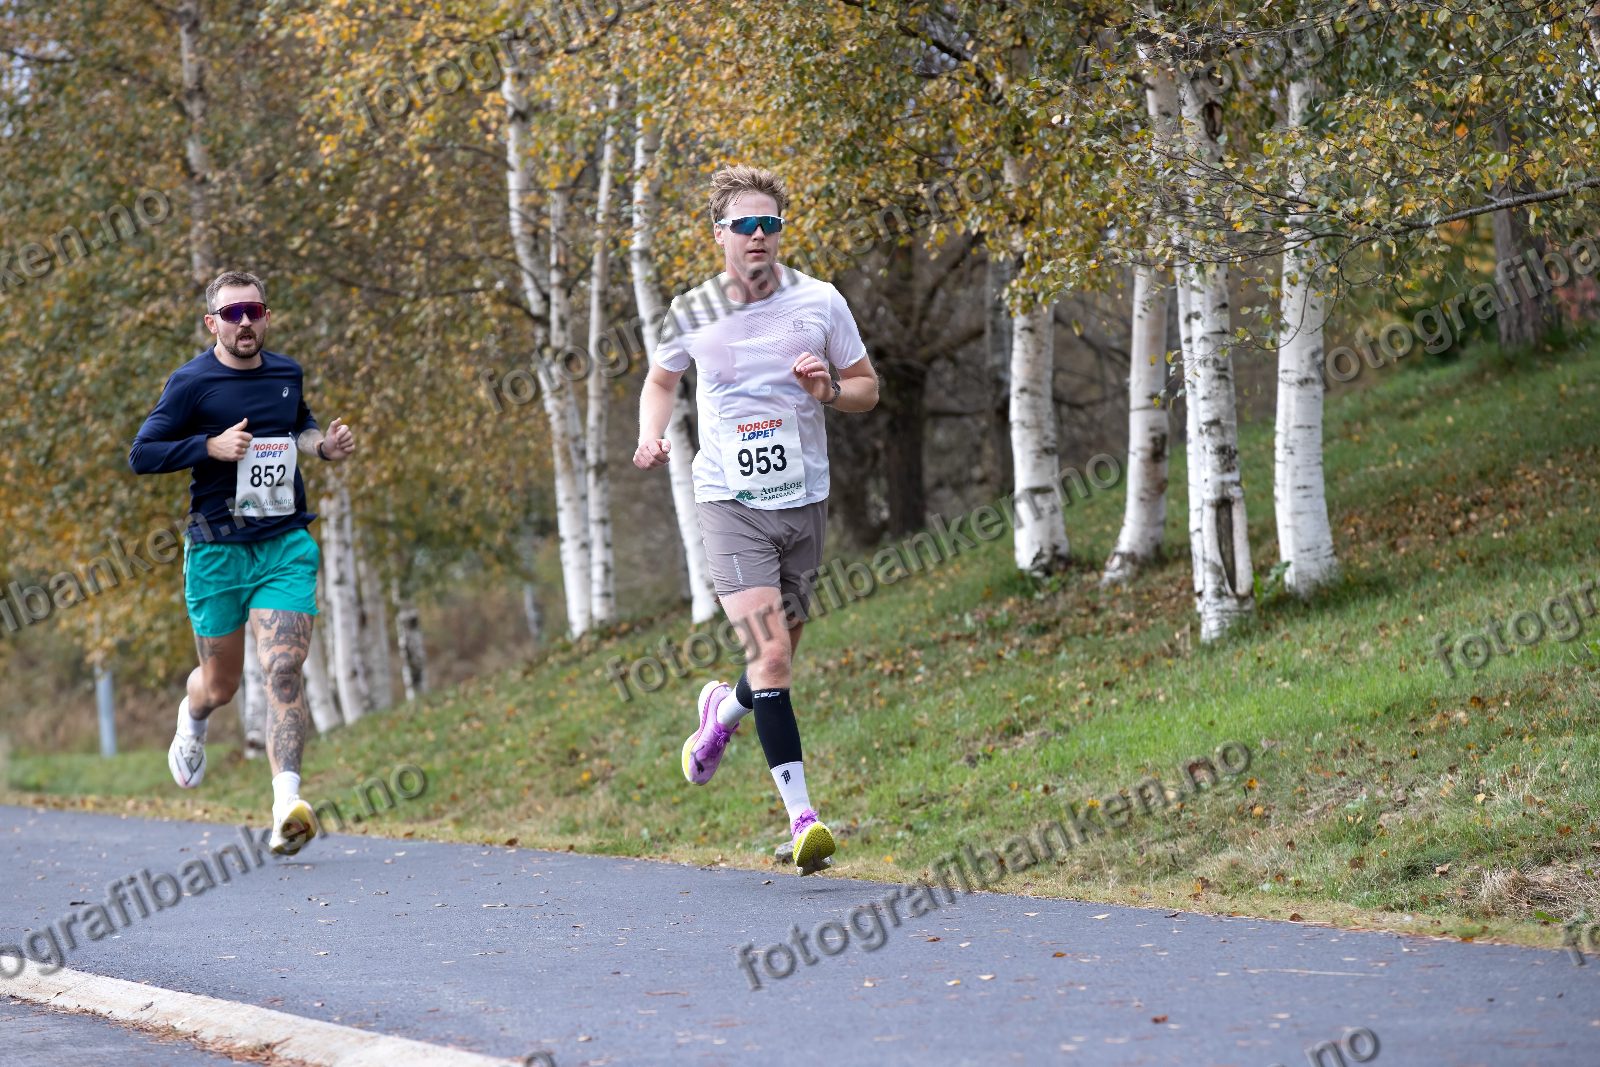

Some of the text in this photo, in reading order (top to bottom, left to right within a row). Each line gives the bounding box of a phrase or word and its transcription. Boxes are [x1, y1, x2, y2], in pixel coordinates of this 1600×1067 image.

[737, 418, 783, 433] NORGES
[741, 428, 776, 441] LØPET
[253, 443, 289, 451] NORGES
[737, 444, 787, 477] 953
[250, 464, 286, 488] 852
[760, 481, 803, 496] Aurskog
